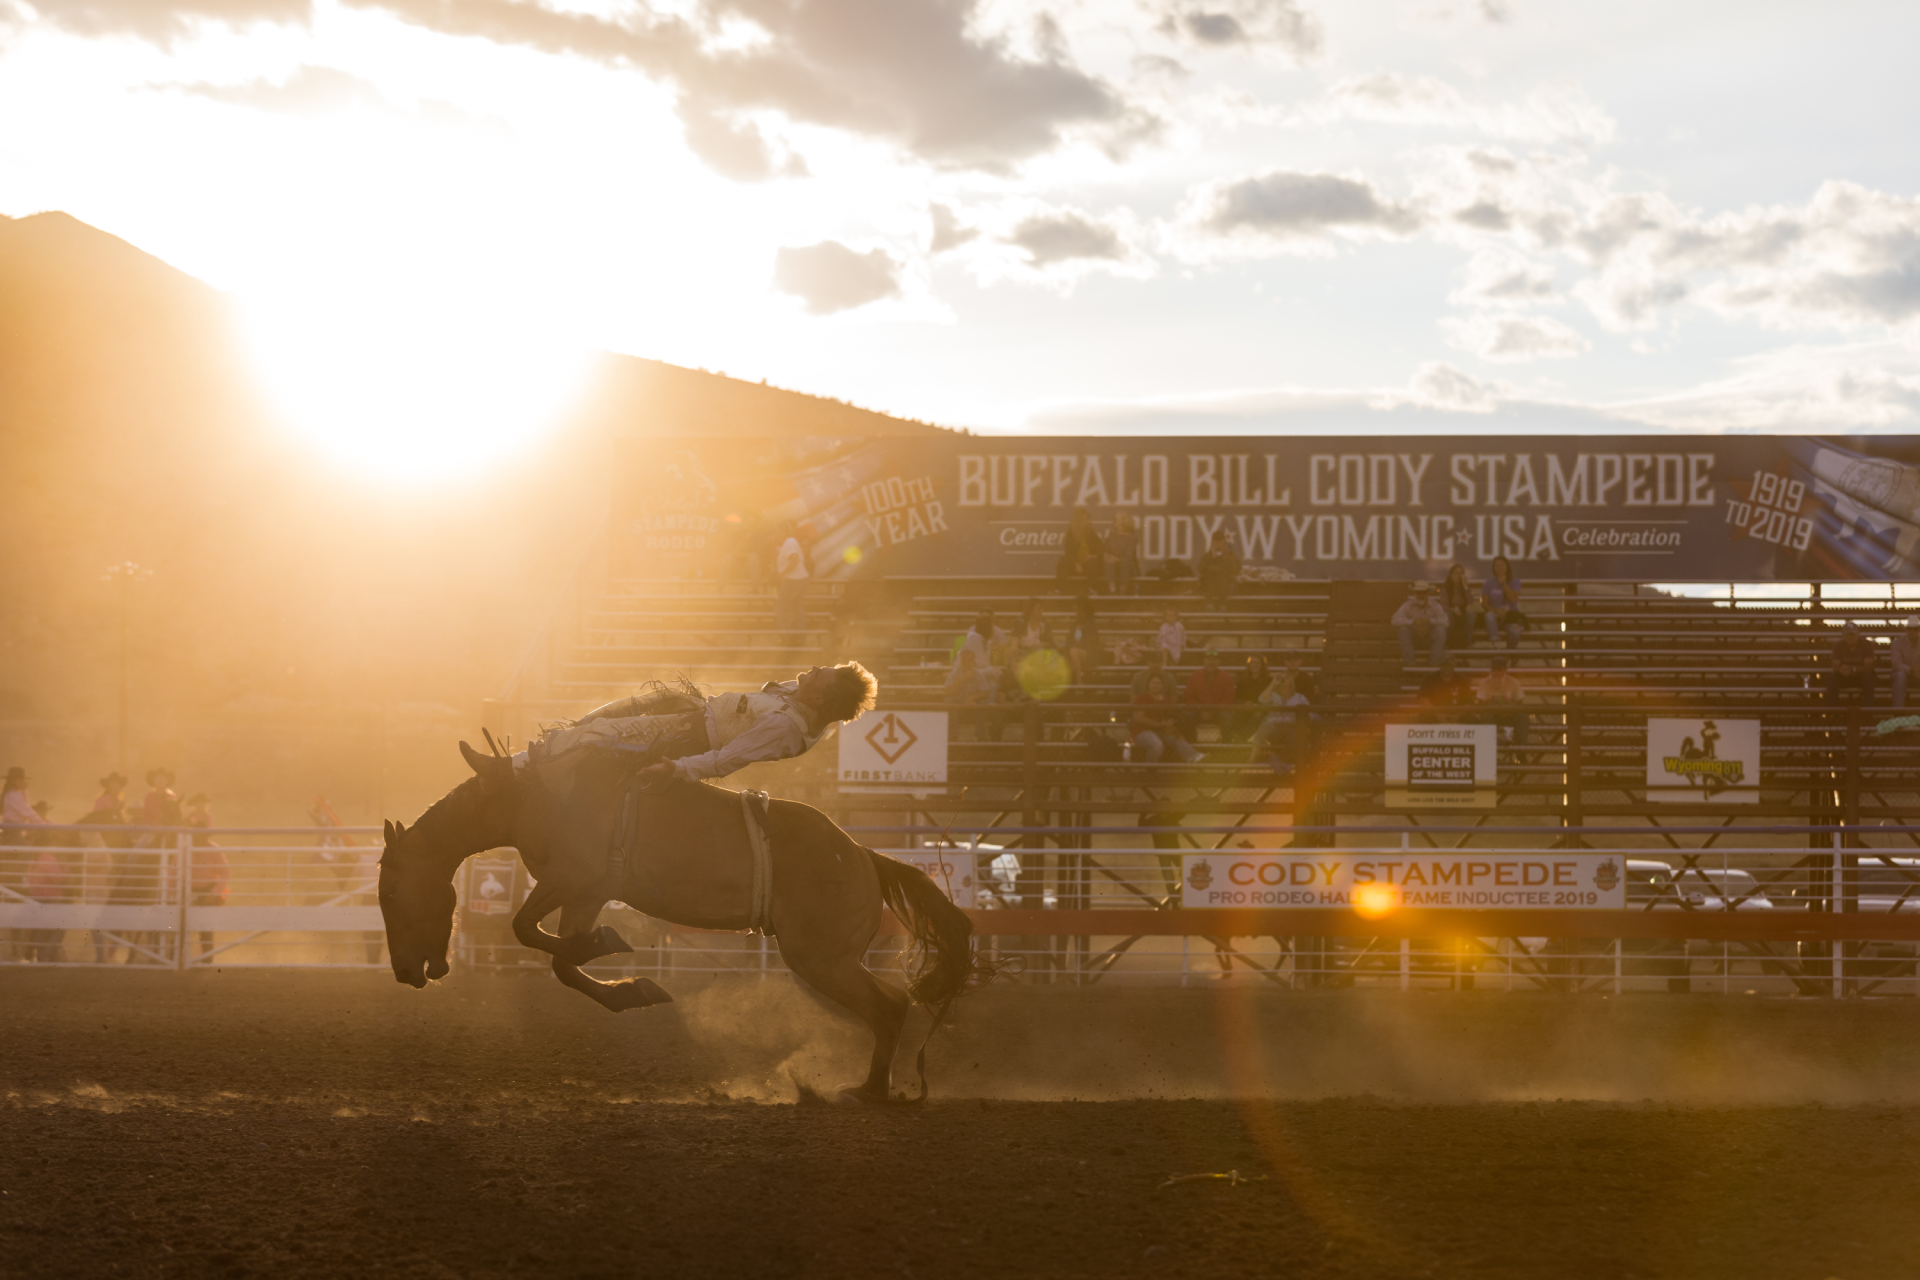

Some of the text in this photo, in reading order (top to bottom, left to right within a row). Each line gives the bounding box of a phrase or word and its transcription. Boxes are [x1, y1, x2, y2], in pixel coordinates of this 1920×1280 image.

[958, 454, 1716, 507] BUFFALO BILL CODY STAMPEDE
[1748, 469, 1806, 513] 1919
[861, 475, 935, 515] 100TH
[632, 513, 719, 534] STAMPEDE
[864, 500, 950, 548] YEAR
[1724, 498, 1814, 551] TO 2019
[646, 536, 706, 549] RODEO
[1131, 514, 1561, 561] ODY WYOMING USA
[1562, 527, 1682, 547] Celebration
[1407, 729, 1475, 739] Don't miss it!
[1412, 747, 1472, 755] BUFFALO BILL
[1411, 757, 1471, 768] CENTER
[1412, 770, 1471, 778] OF THE WEST
[1228, 862, 1342, 886] CODY
[1352, 862, 1578, 886] STAMPEDE
[1209, 891, 1246, 904] PRO
[1251, 891, 1315, 904] RODEO
[1402, 891, 1452, 904] FAME
[1456, 891, 1550, 904] INDUCTEE
[1554, 891, 1598, 904] 2019
